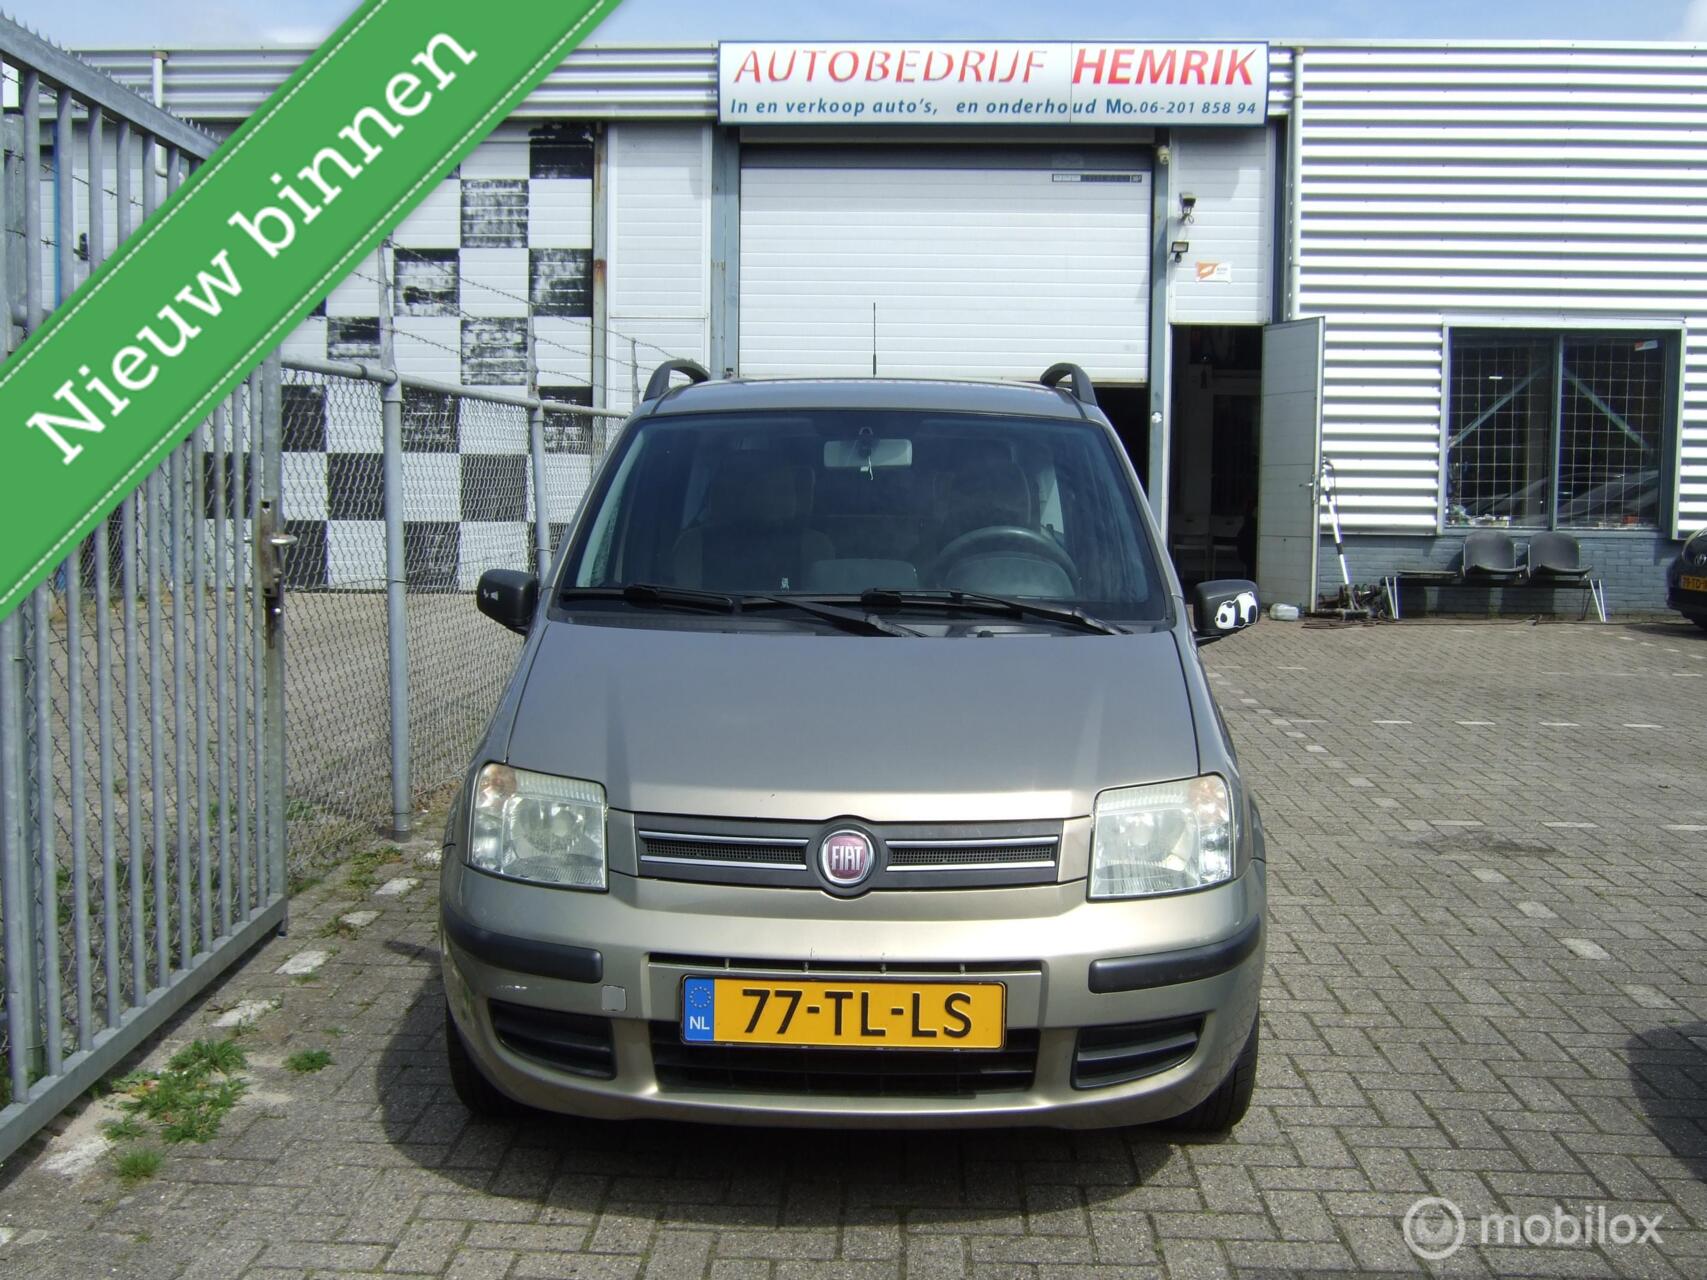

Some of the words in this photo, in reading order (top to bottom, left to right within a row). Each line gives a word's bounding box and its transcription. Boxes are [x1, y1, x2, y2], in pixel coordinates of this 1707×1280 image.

[734, 48, 1048, 84] AUTOBEDRIJF
[1072, 48, 1257, 85] HEMRIK
[731, 99, 748, 114] In
[756, 102, 778, 114] en
[786, 98, 865, 117] verkoop
[956, 102, 979, 114] en
[986, 98, 1097, 115] onderhoud
[1201, 101, 1231, 115] 858
[1237, 101, 1257, 115] 94
[831, 845, 864, 871] FIAT
[689, 1015, 710, 1030] NL
[742, 988, 973, 1038] 77-TL-LS
